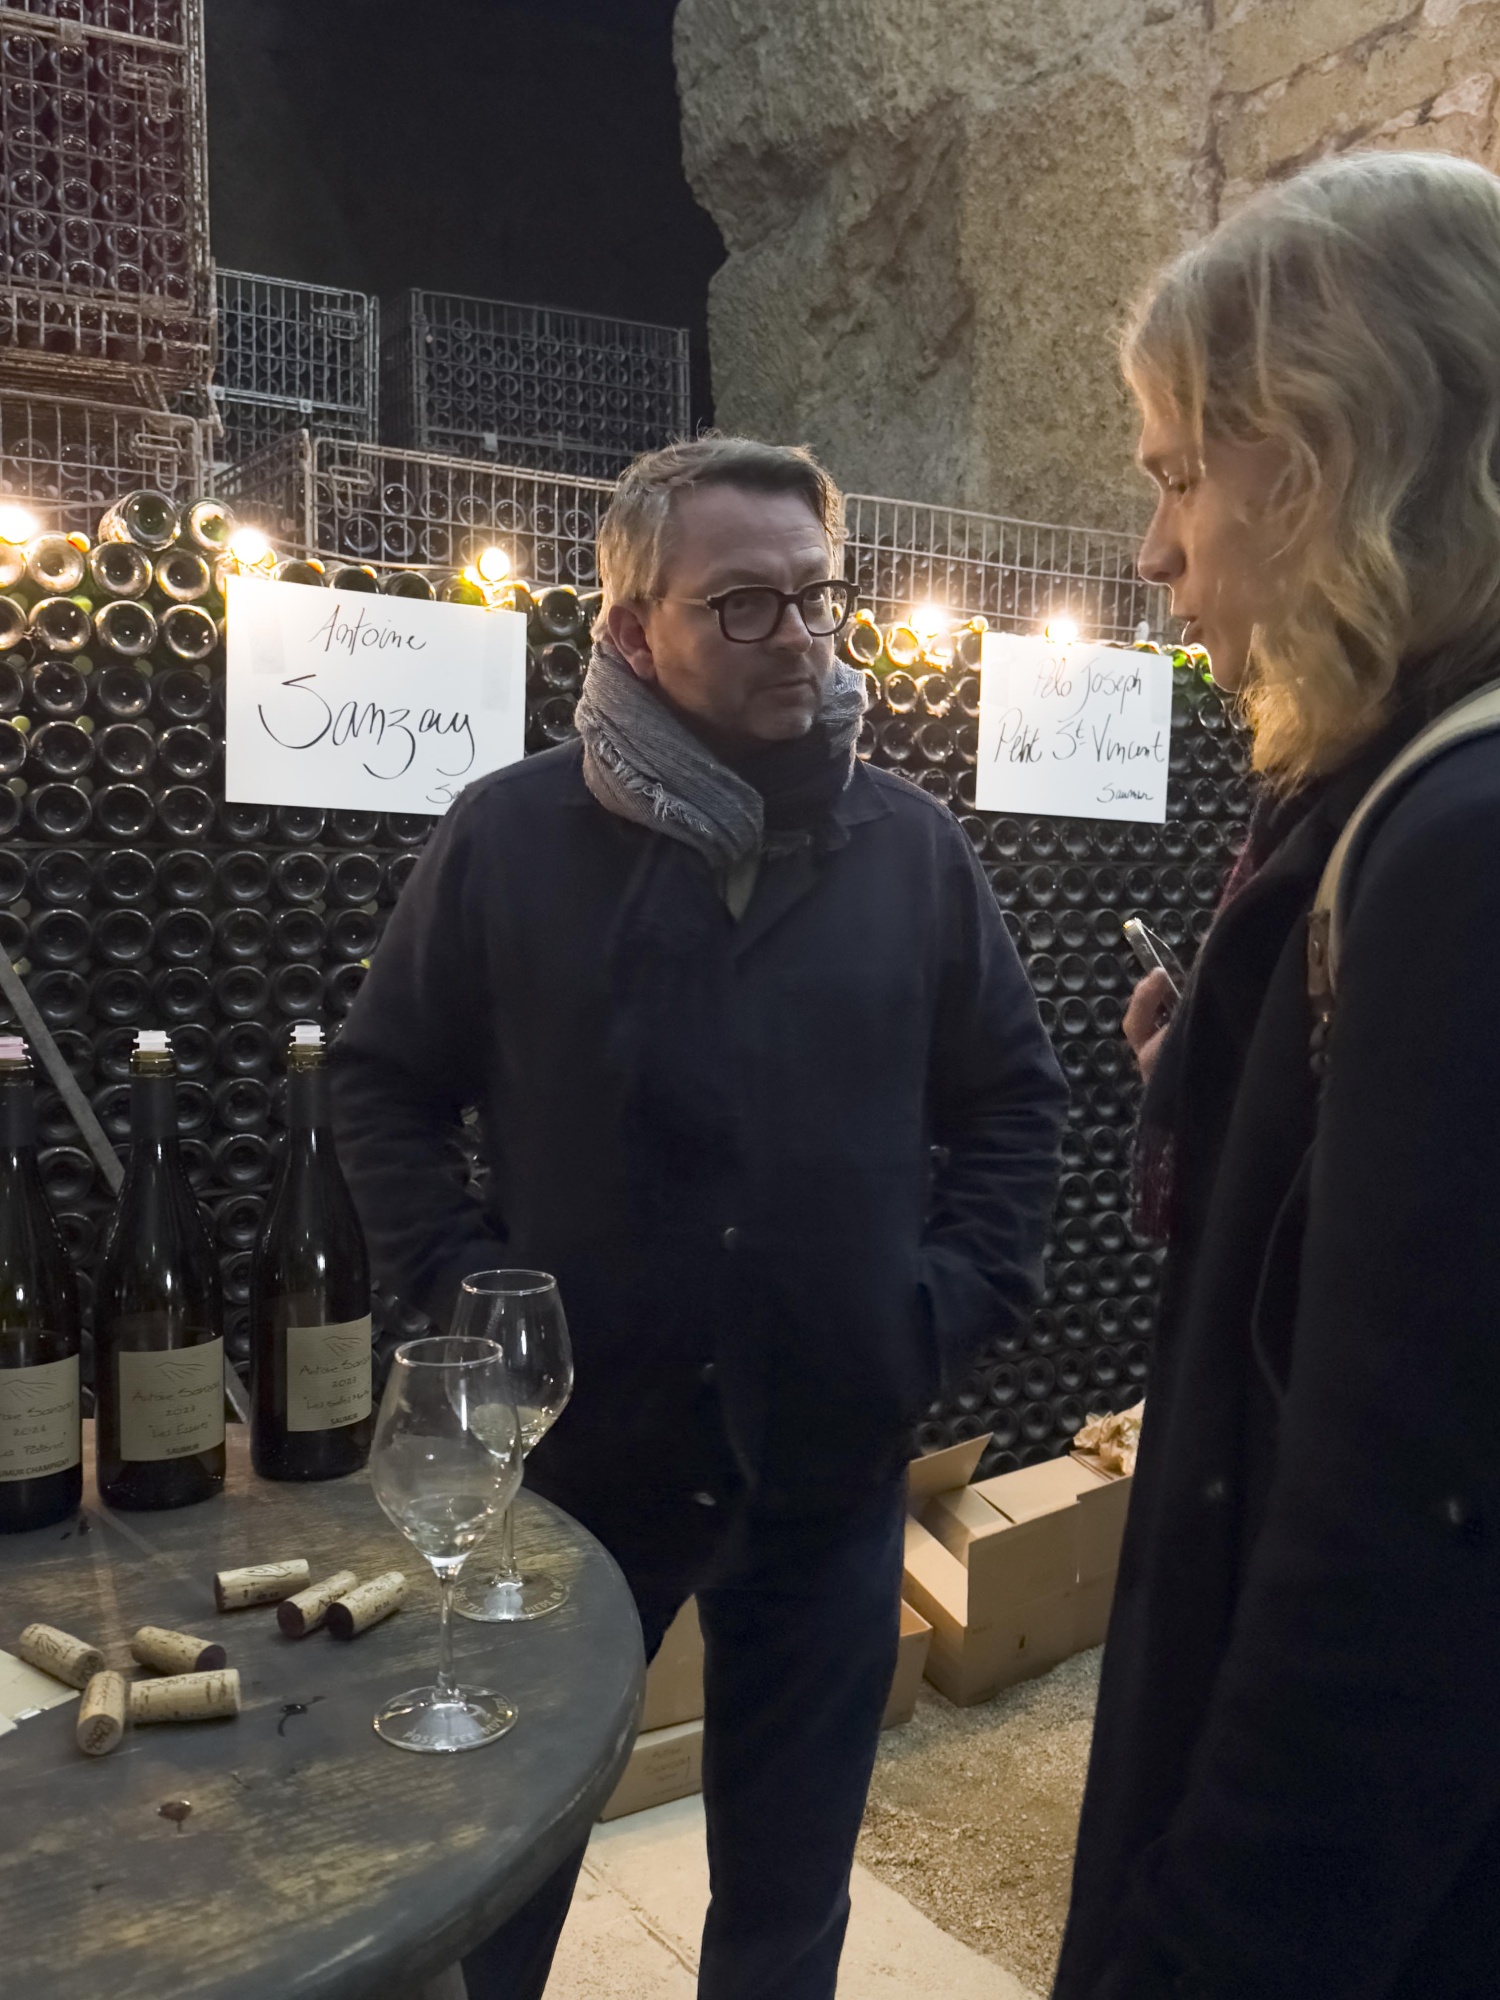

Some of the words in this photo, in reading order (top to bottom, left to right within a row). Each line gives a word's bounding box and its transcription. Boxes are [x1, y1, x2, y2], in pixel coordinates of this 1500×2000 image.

[308, 604, 426, 655] Antoine
[1058, 657, 1141, 722] Joseph
[258, 674, 475, 779] Sanzay
[1092, 713, 1165, 764] Vincent
[330, 1413, 358, 1425] SAUMUR
[26, 1458, 69, 1475] CHAMPIGNY
